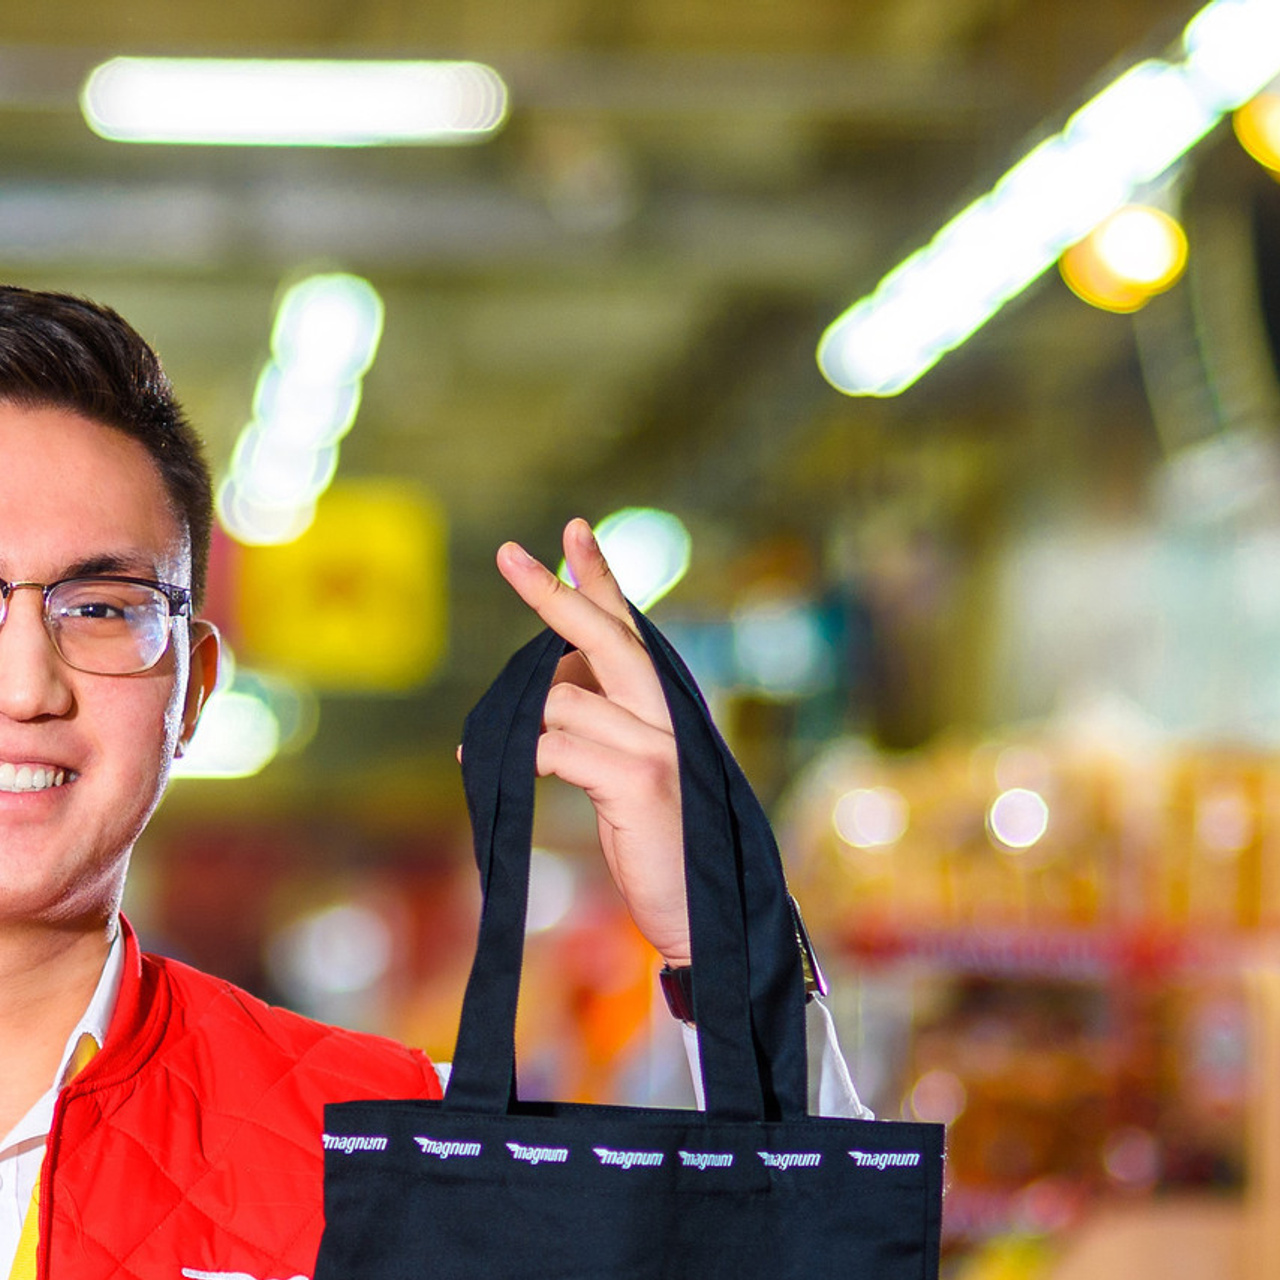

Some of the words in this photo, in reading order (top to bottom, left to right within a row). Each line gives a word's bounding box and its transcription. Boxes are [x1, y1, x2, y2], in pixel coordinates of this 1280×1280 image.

[323, 1134, 388, 1154] magnum
[414, 1137, 482, 1159] magnum
[506, 1143, 569, 1165] magnum
[593, 1148, 664, 1170] magnum
[679, 1151, 734, 1170] magnum
[848, 1151, 921, 1171] magnum
